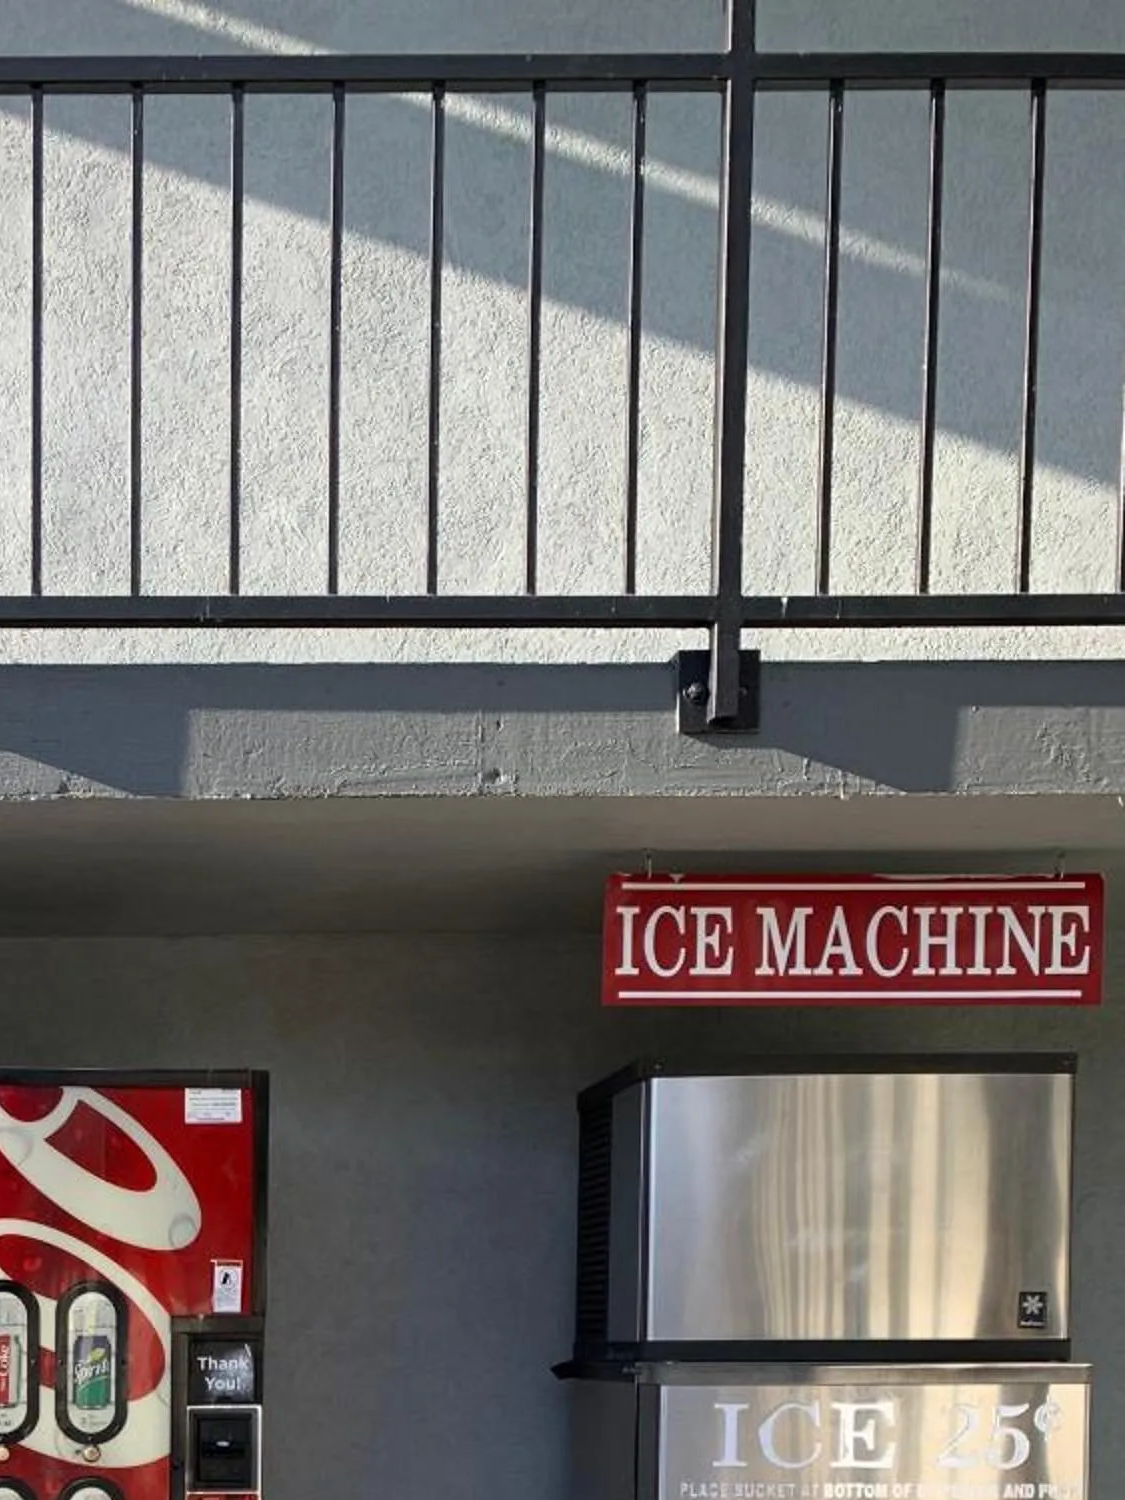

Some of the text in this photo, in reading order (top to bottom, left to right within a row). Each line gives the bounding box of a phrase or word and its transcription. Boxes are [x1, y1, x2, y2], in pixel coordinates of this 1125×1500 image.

[615, 905, 1091, 977] ICE MACHINE
[197, 1355, 249, 1371] Thank
[205, 1376, 240, 1391] You!
[712, 1401, 896, 1470] ICE
[680, 1482, 726, 1499] PLACE
[824, 1482, 888, 1499] BOTTOM
[1002, 1483, 1036, 1500] AND
